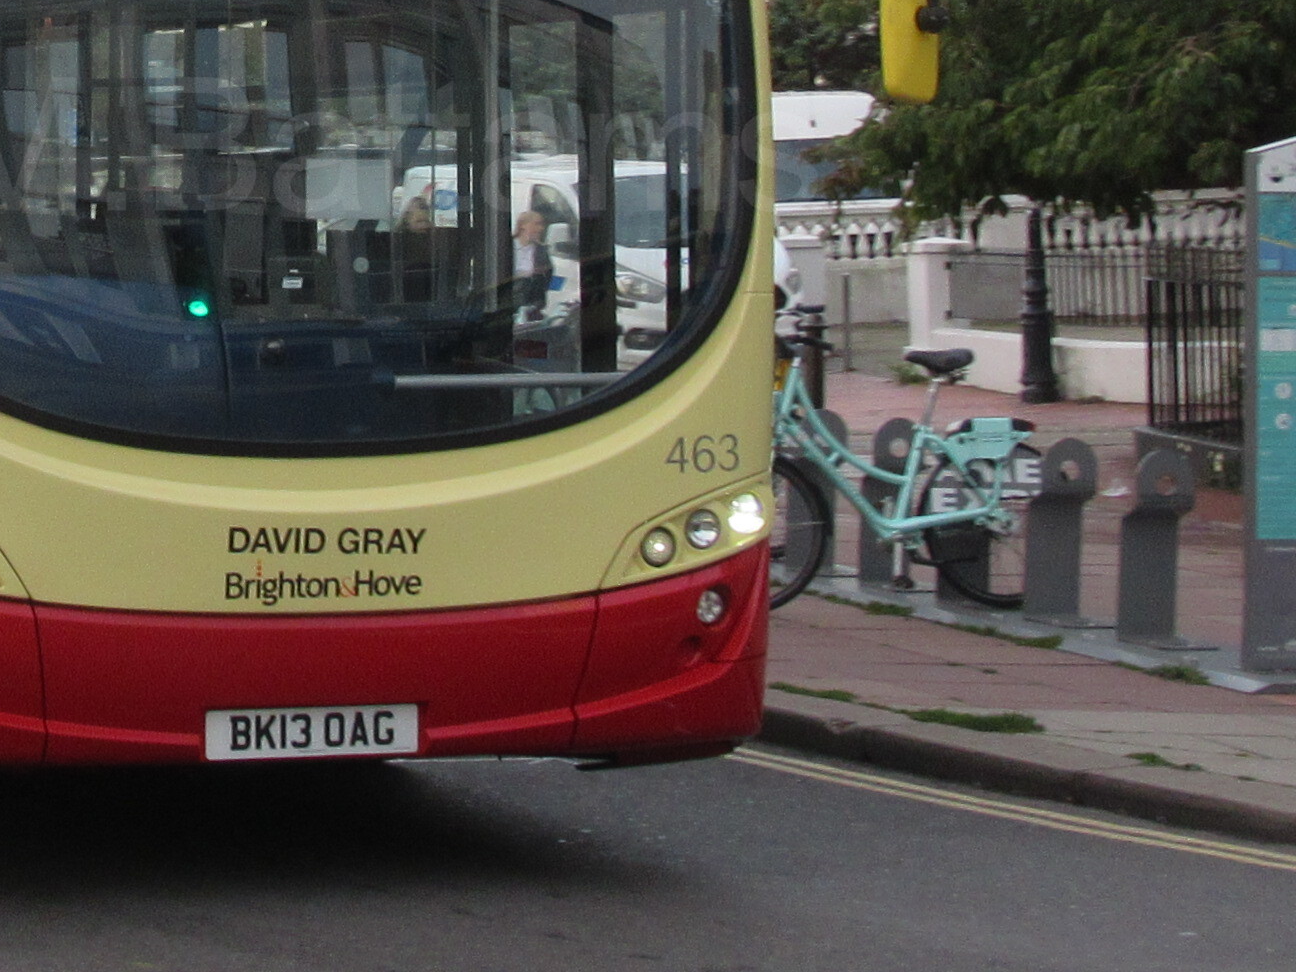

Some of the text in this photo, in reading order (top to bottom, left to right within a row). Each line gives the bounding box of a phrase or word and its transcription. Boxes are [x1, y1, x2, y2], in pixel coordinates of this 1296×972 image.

[665, 434, 740, 474] 463
[228, 526, 426, 554] DAVID GRAY
[230, 710, 395, 751] BK13 OAG
